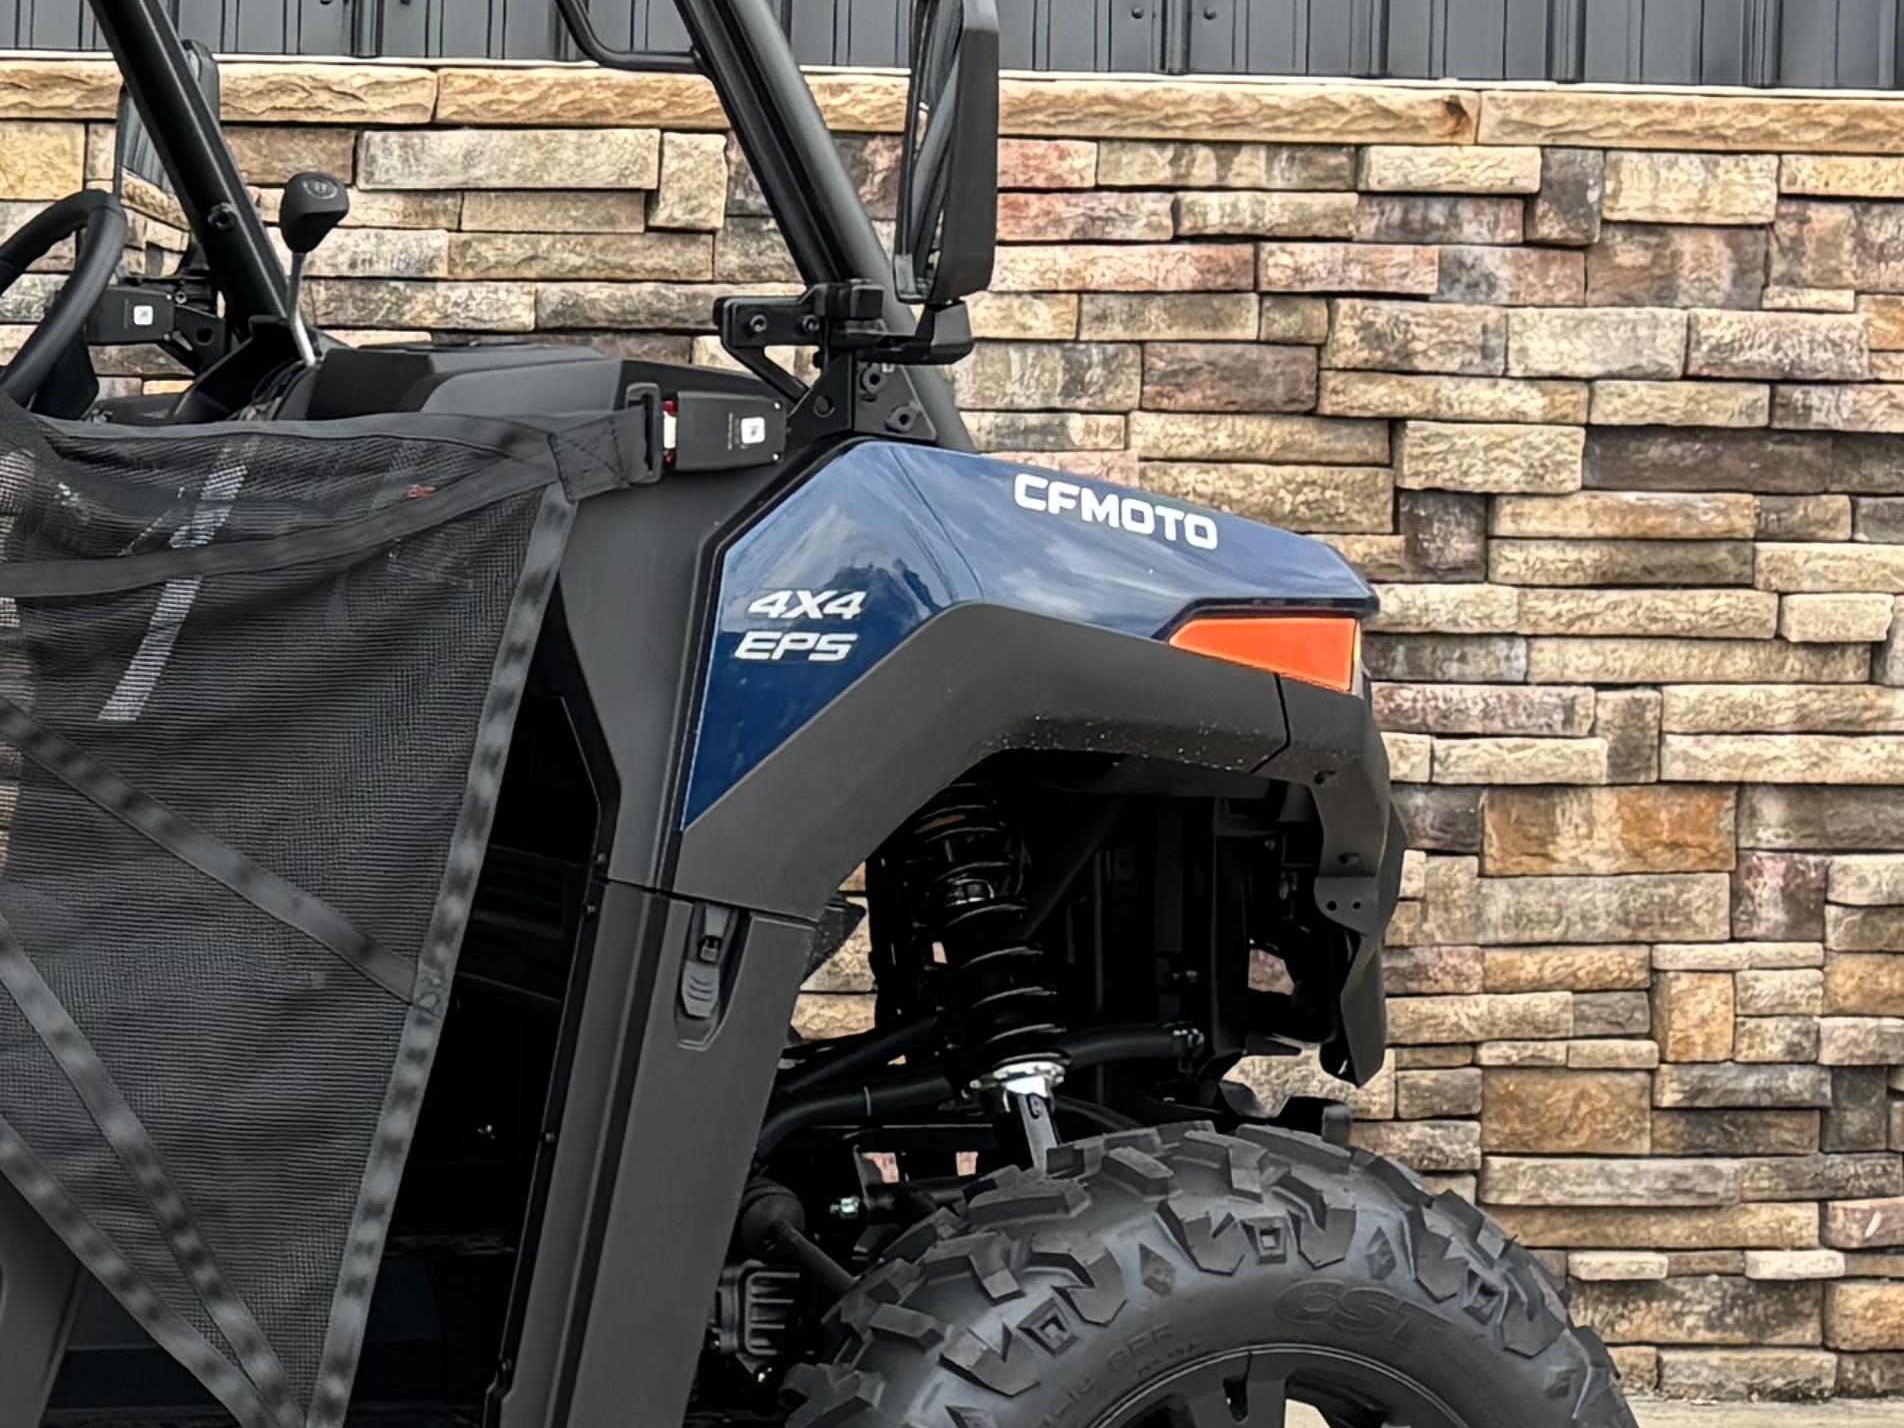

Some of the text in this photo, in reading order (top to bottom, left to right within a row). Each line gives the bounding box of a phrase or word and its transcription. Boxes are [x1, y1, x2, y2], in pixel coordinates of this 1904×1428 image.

[1014, 473, 1219, 550] CFMOTO
[747, 589, 866, 622] 4X4
[733, 630, 859, 662] EPS
[1274, 1278, 1457, 1352] CST
